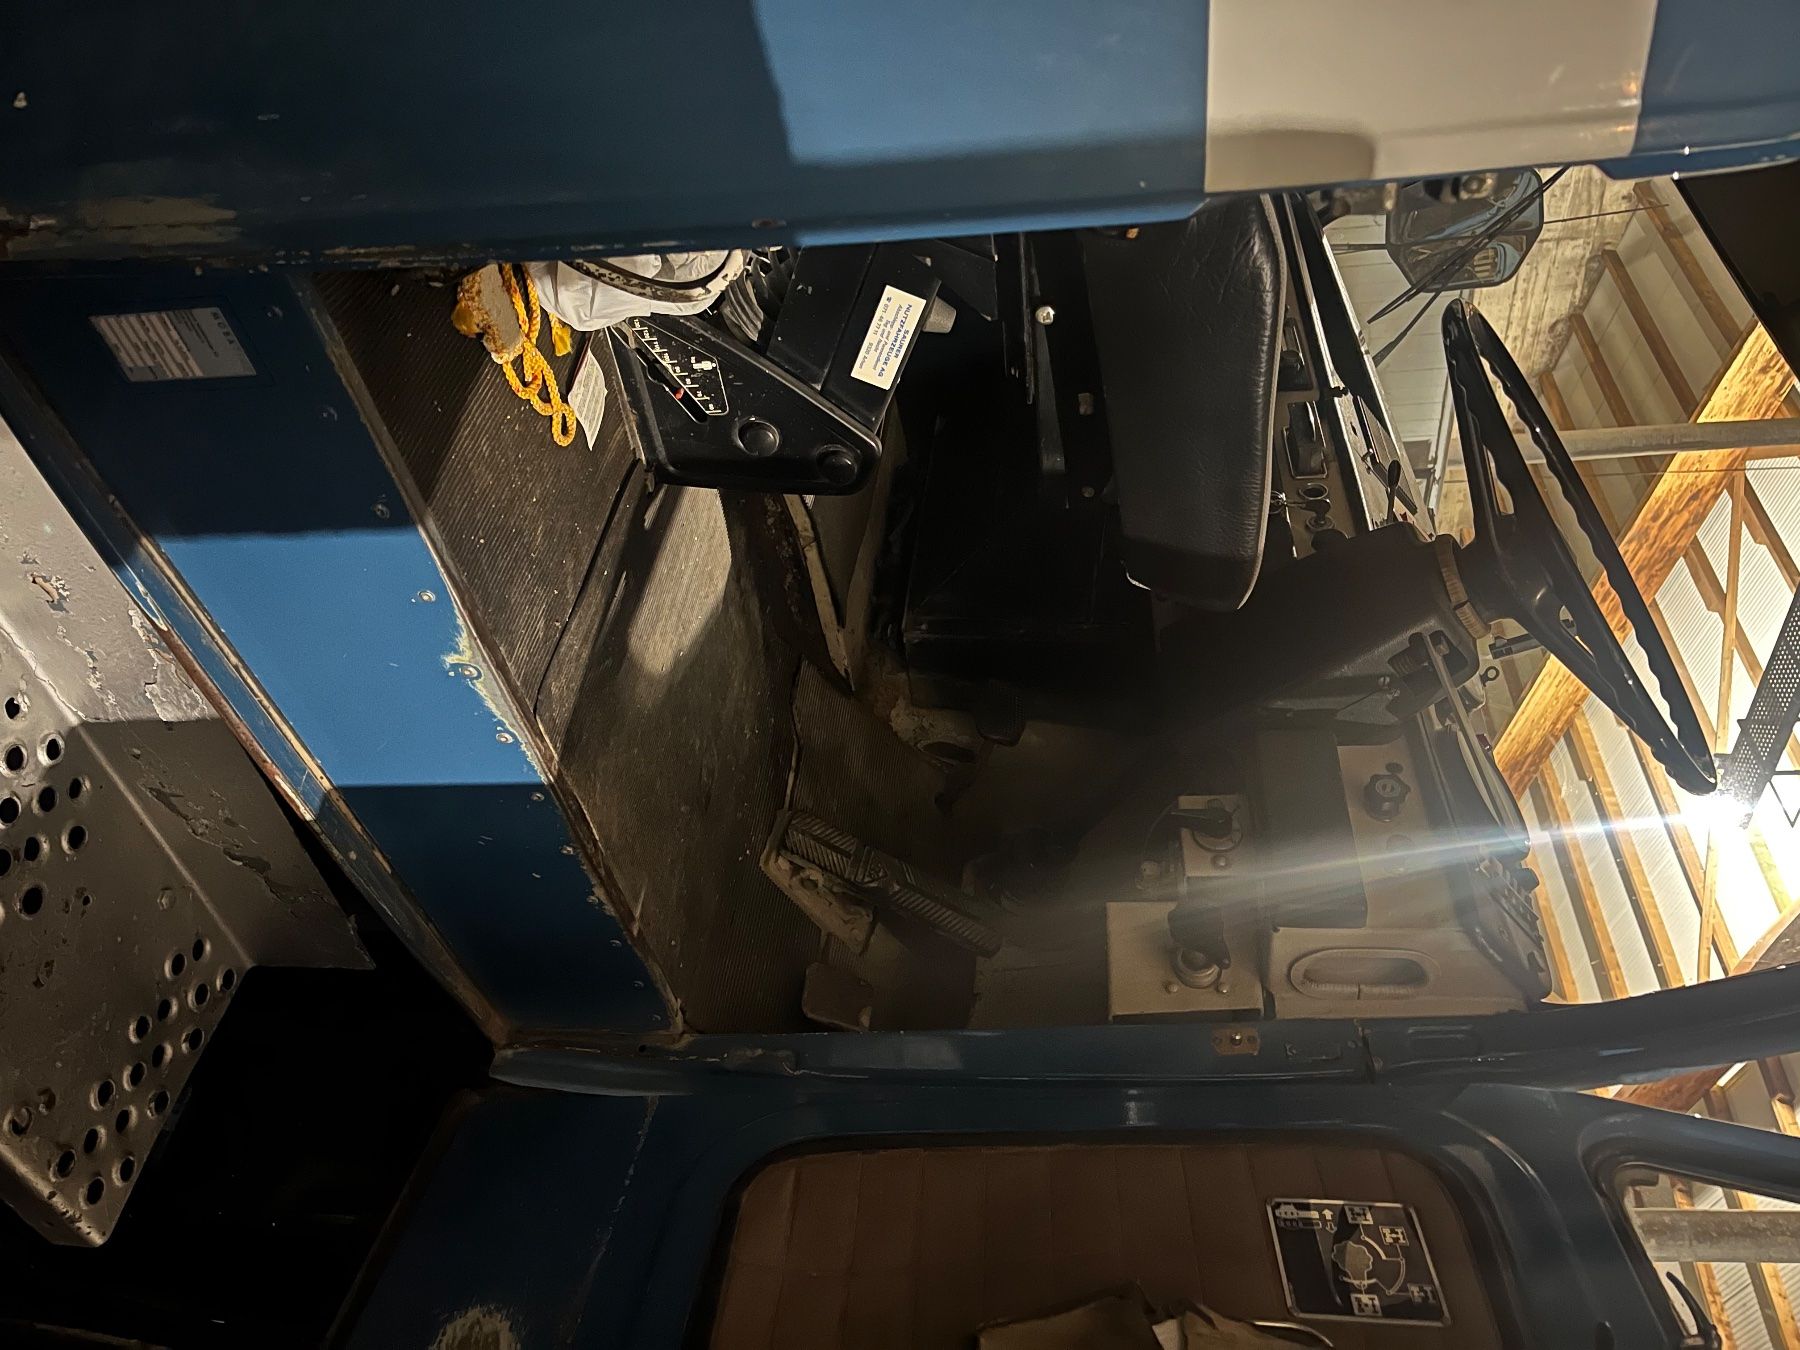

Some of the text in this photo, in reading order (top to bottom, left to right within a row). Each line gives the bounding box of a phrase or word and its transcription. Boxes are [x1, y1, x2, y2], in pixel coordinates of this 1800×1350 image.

[877, 303, 912, 377] NUTZFAHRZEUGE AG
[893, 329, 909, 358] SAURER
